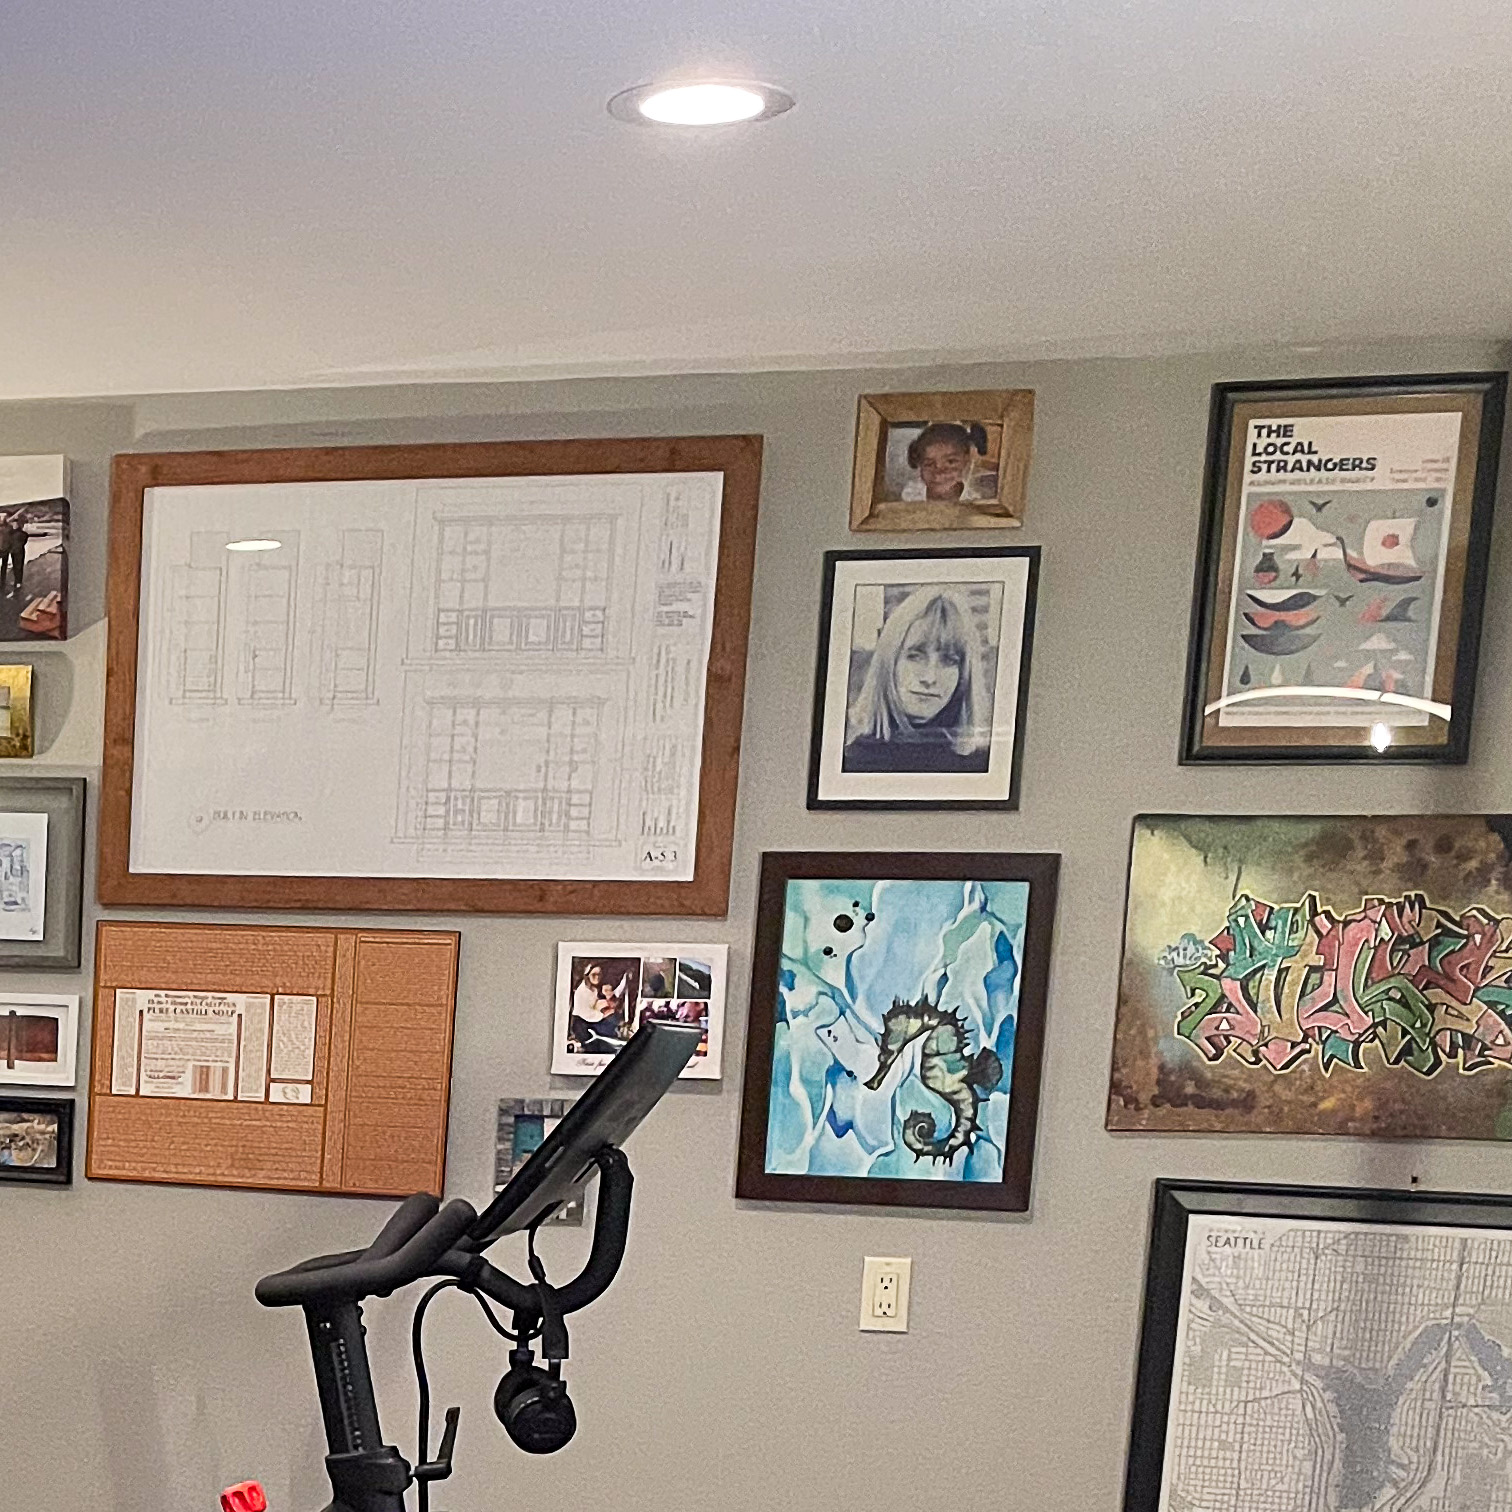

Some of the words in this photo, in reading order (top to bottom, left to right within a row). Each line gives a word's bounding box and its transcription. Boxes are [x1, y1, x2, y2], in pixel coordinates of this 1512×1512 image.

[1254, 424, 1295, 439] THE
[1251, 441, 1319, 457] LOCAL
[1250, 457, 1377, 474] STRANGERS
[643, 851, 677, 862] A-53
[1206, 1234, 1266, 1250] SEATTLE
